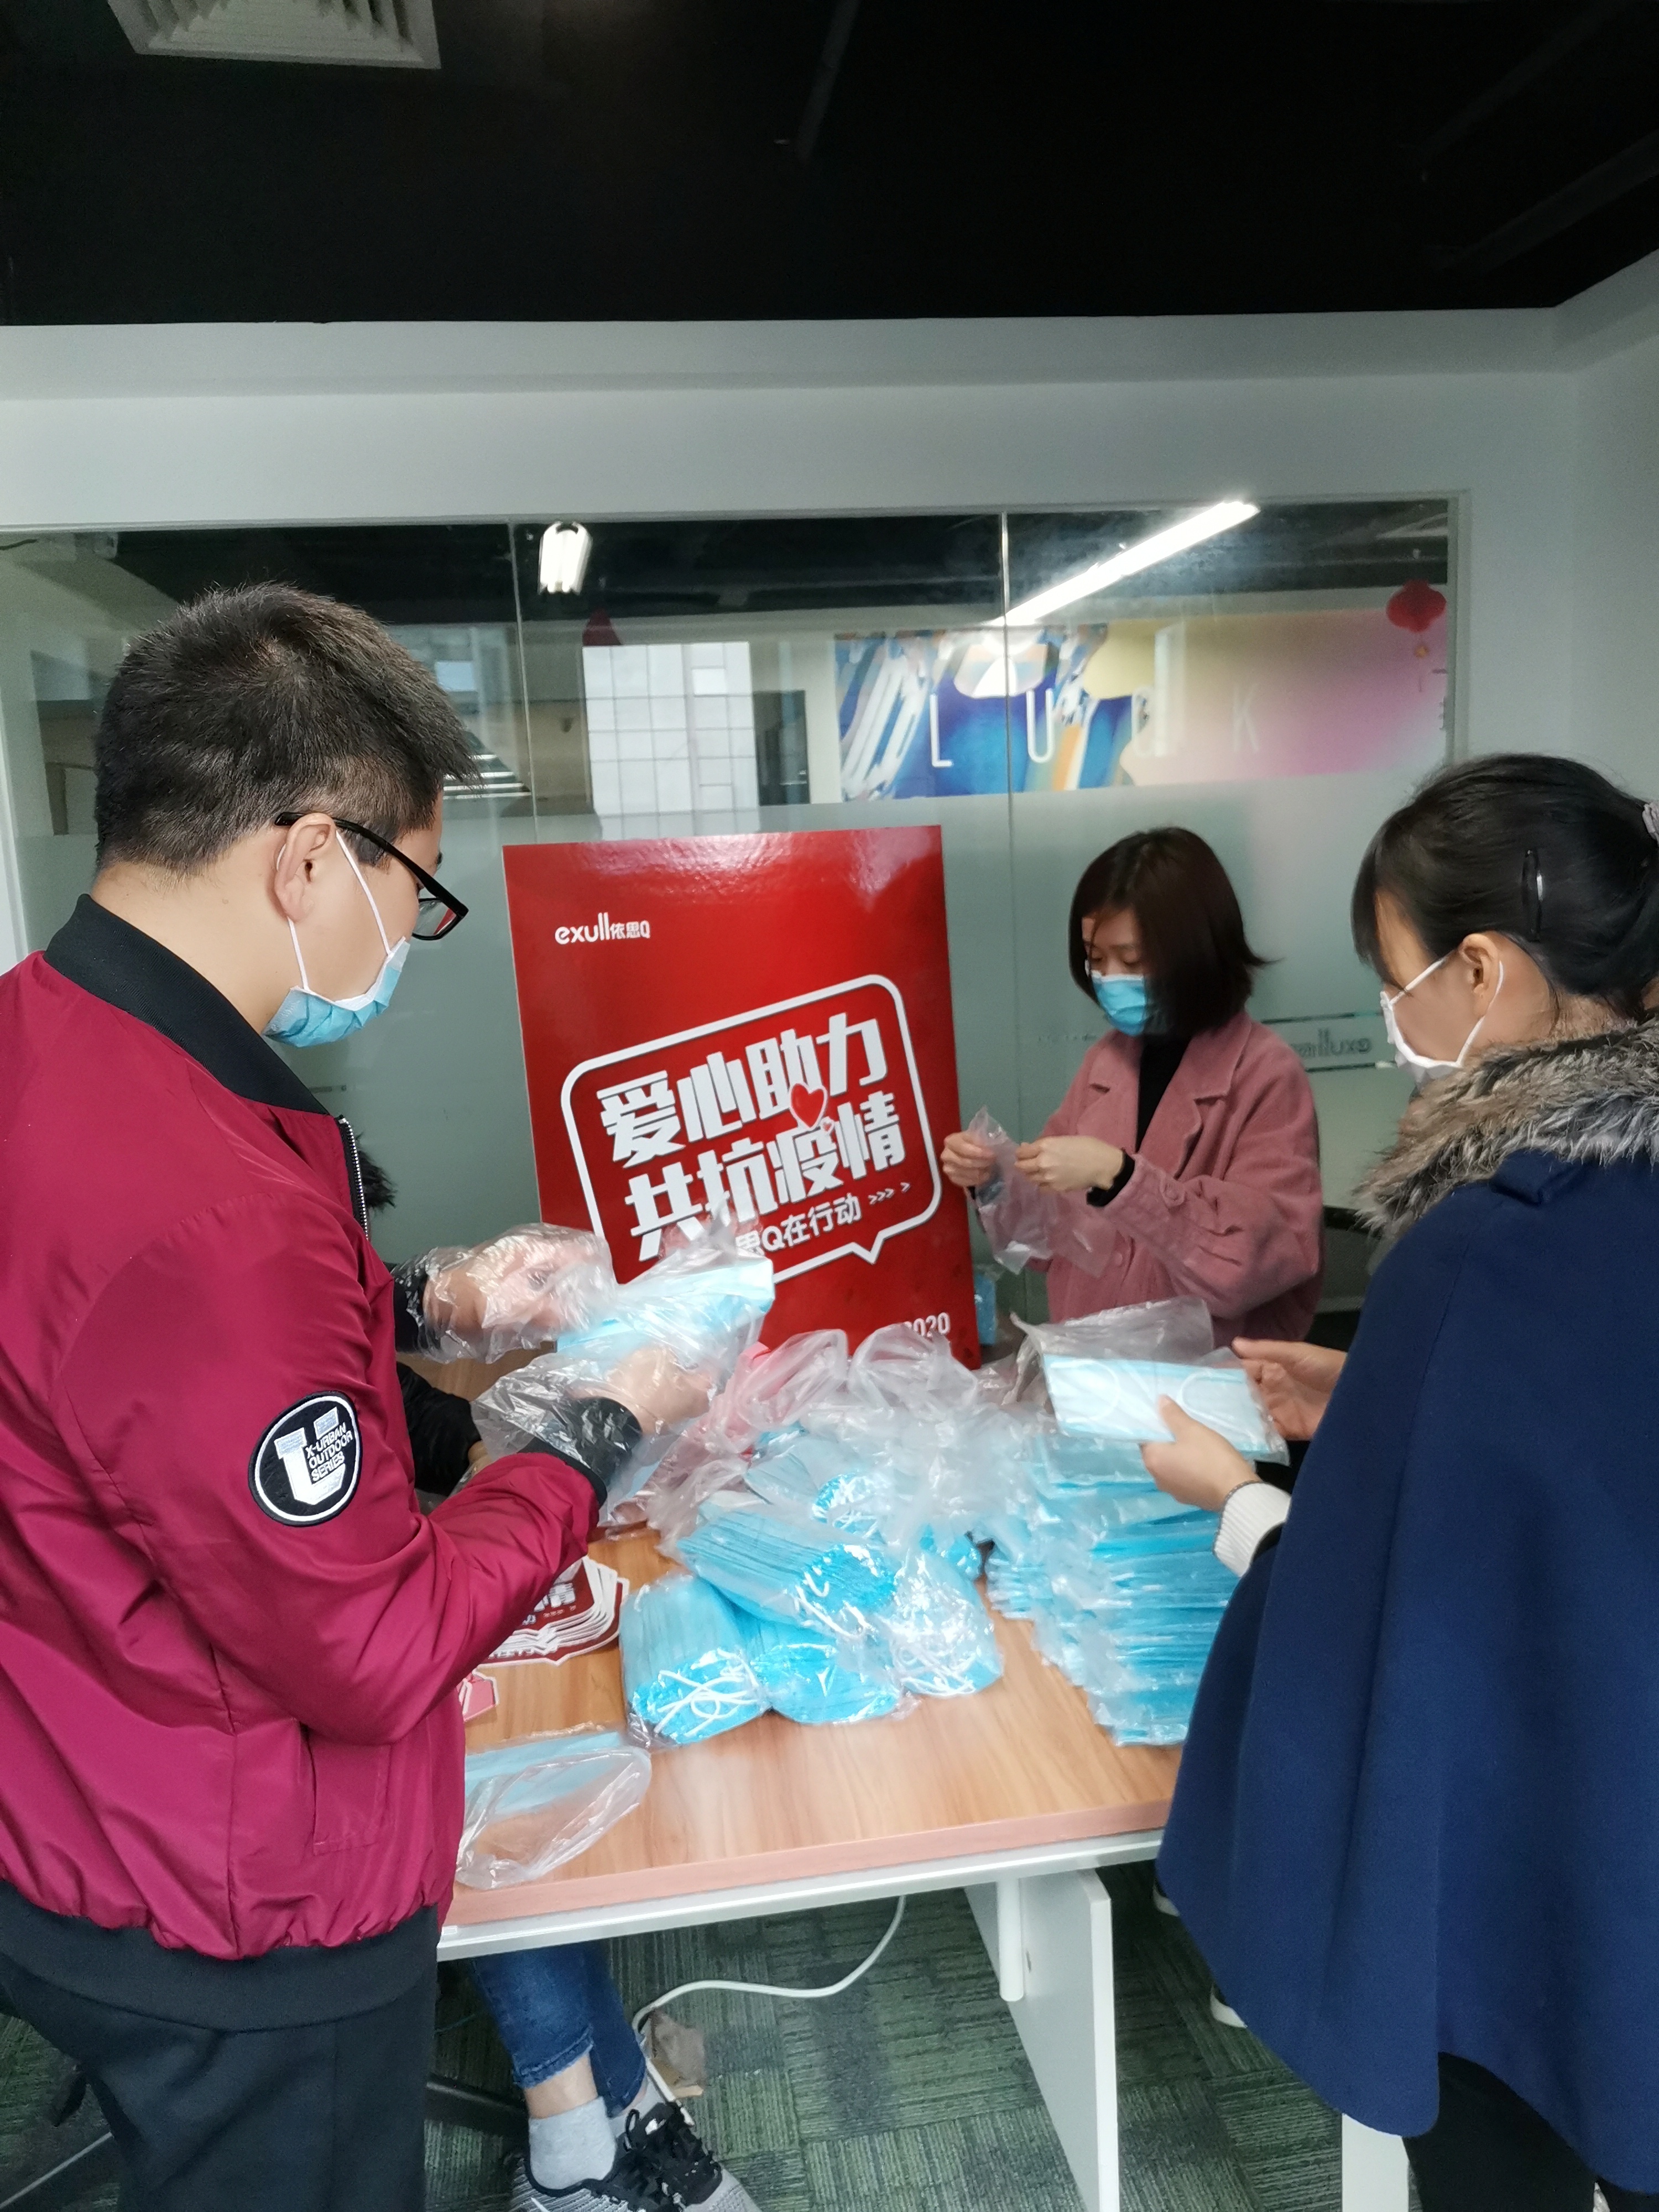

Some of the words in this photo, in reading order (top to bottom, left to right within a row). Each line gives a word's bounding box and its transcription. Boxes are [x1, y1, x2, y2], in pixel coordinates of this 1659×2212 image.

[596, 1012, 888, 1168] 爱心助力
[624, 1090, 906, 1262] 共抗疫情
[735, 1192, 862, 1256] 思Q在行动
[904, 1312, 951, 1339] 020
[305, 1422, 346, 1458] X-URBAN
[309, 1430, 353, 1469] OUTDOOR
[311, 1451, 345, 1481] SERIES
